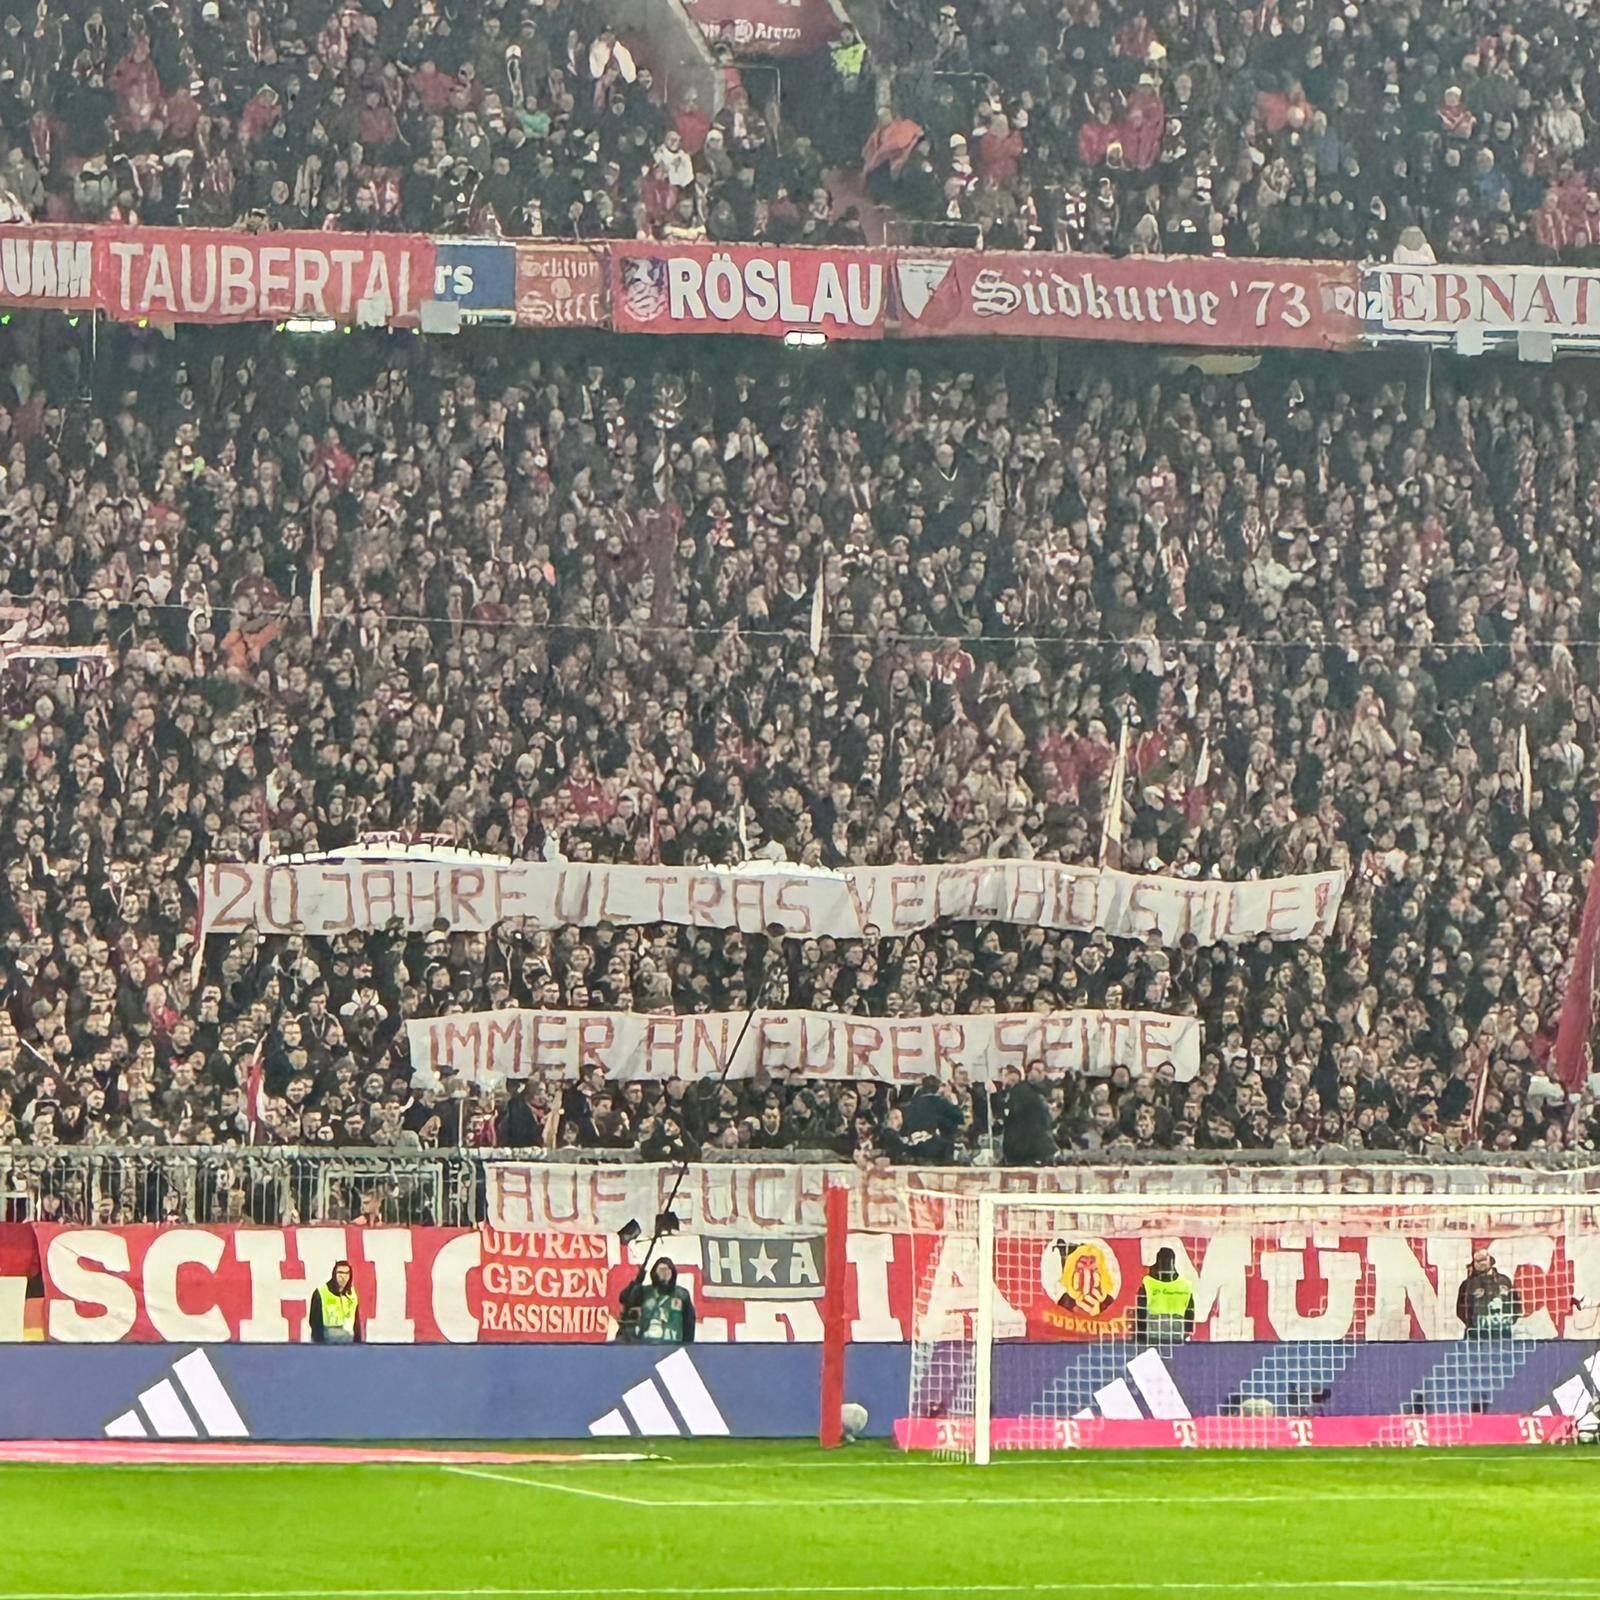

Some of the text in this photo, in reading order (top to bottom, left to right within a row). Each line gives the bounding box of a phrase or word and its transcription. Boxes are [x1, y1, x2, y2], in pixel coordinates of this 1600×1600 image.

[667, 252, 883, 327] RÖSLAU
[971, 268, 1219, 326] Südkurve
[1231, 279, 1312, 328] '73
[553, 866, 811, 935] ULTRAS
[429, 1012, 1173, 1080] IMMER AN EURER SEITE
[495, 1166, 627, 1226] AUF
[482, 1262, 609, 1299] GEGEN
[481, 1300, 609, 1334] RASSISMUS
